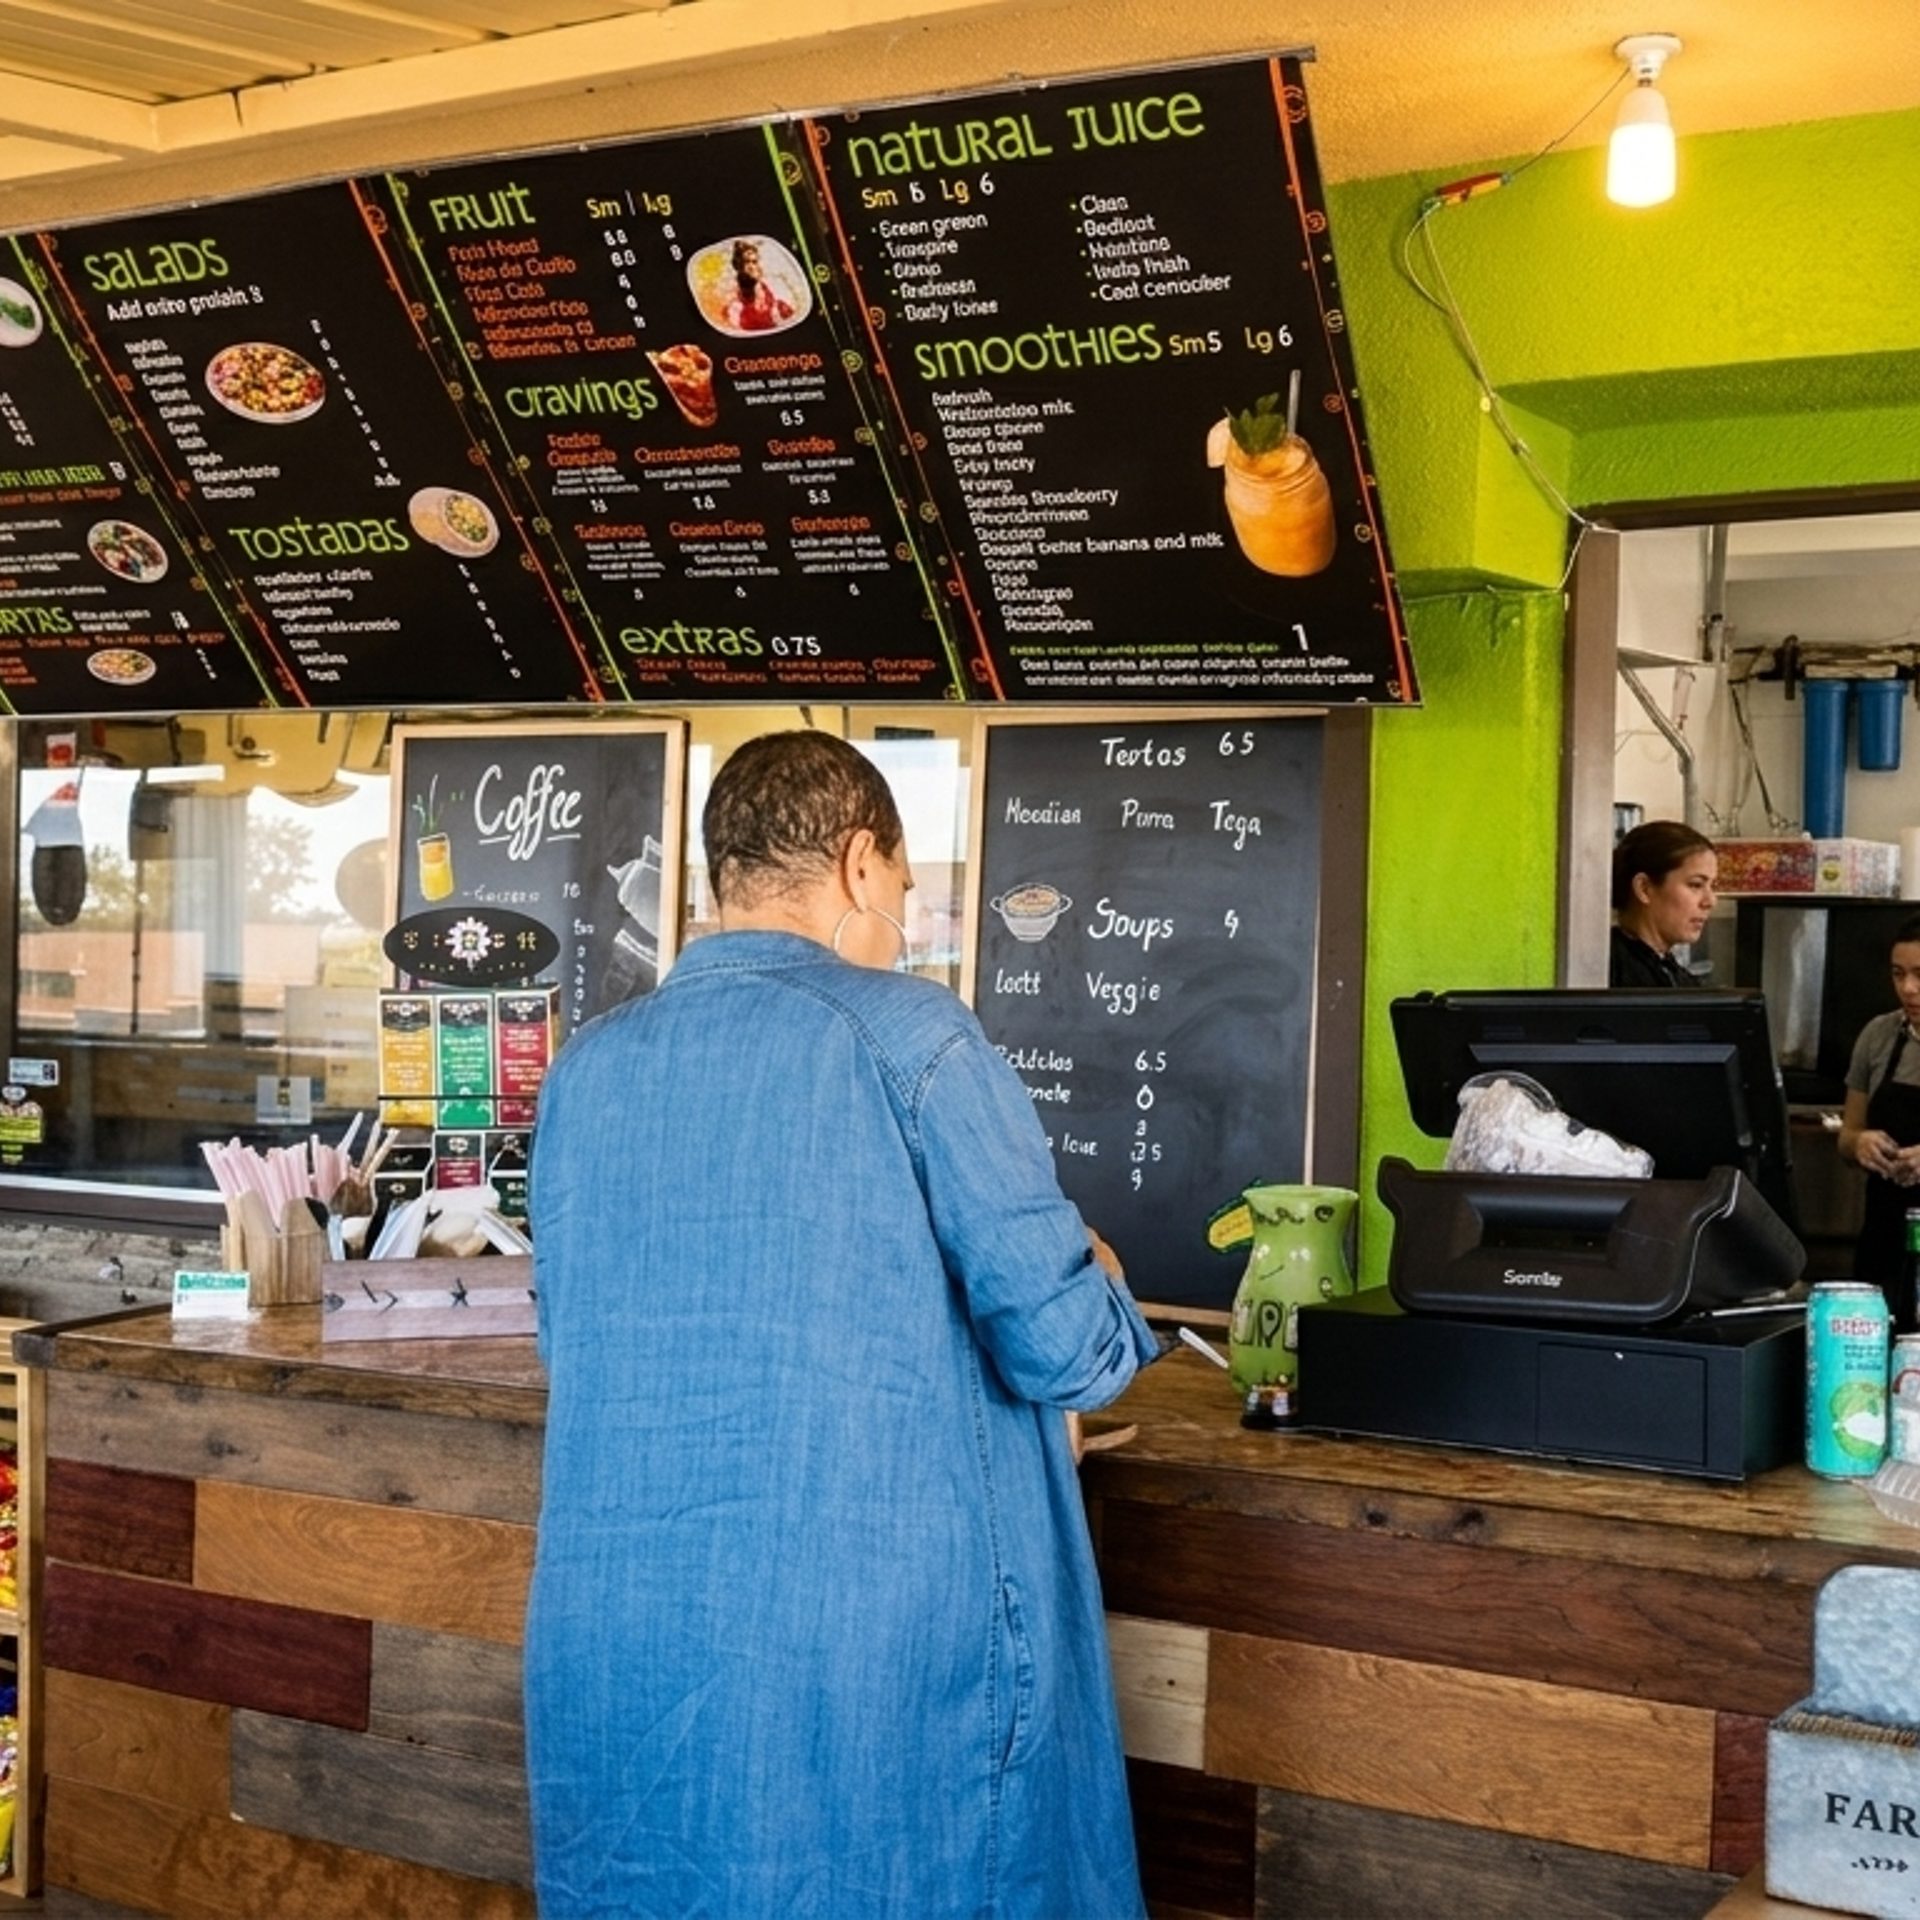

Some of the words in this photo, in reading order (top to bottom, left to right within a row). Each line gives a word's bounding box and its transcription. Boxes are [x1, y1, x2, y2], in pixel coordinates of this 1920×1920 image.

[978, 172, 996, 196] 6
[1279, 324, 1295, 348] 6
[473, 763, 584, 862] Coffee
[1086, 971, 1162, 1017] Veggie
[1824, 1790, 1920, 1839] FAR
